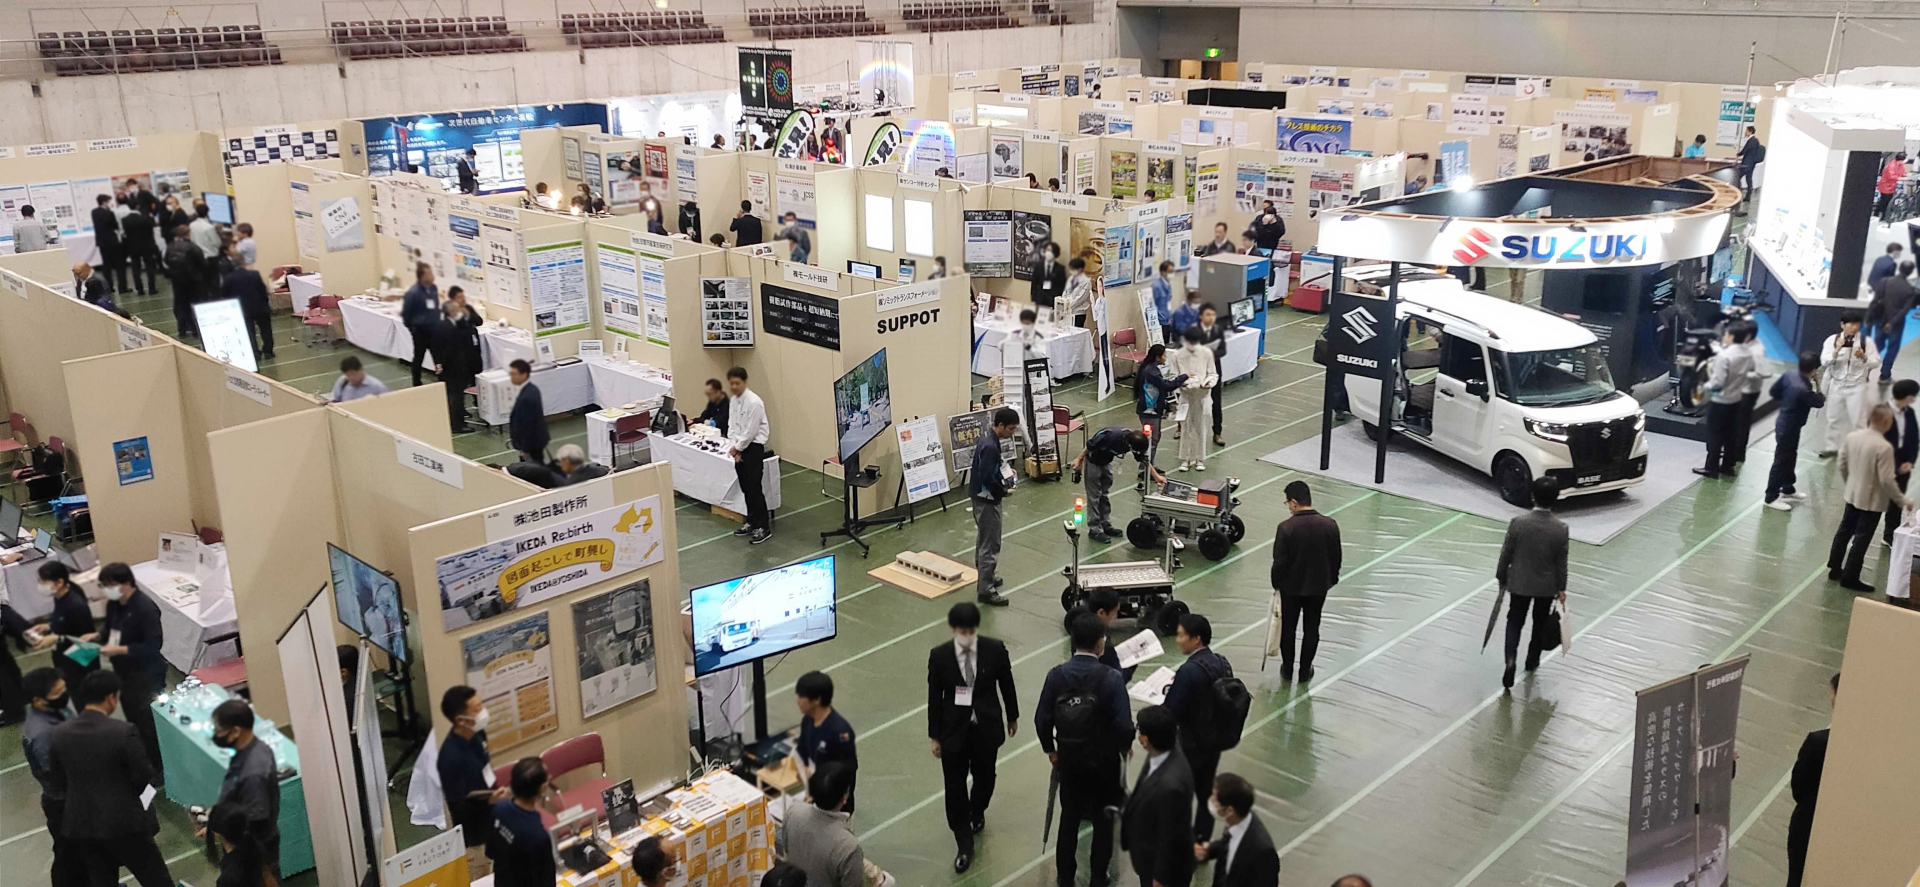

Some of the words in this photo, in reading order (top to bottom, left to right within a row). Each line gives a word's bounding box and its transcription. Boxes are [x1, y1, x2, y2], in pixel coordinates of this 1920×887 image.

[1501, 233, 1647, 262] SUZUKI
[877, 308, 941, 335] SUPPOT
[1336, 353, 1378, 369] SUZUKI
[1577, 474, 1602, 484] BASE
[516, 533, 547, 554] IKEDA
[552, 521, 593, 543] Re:birth
